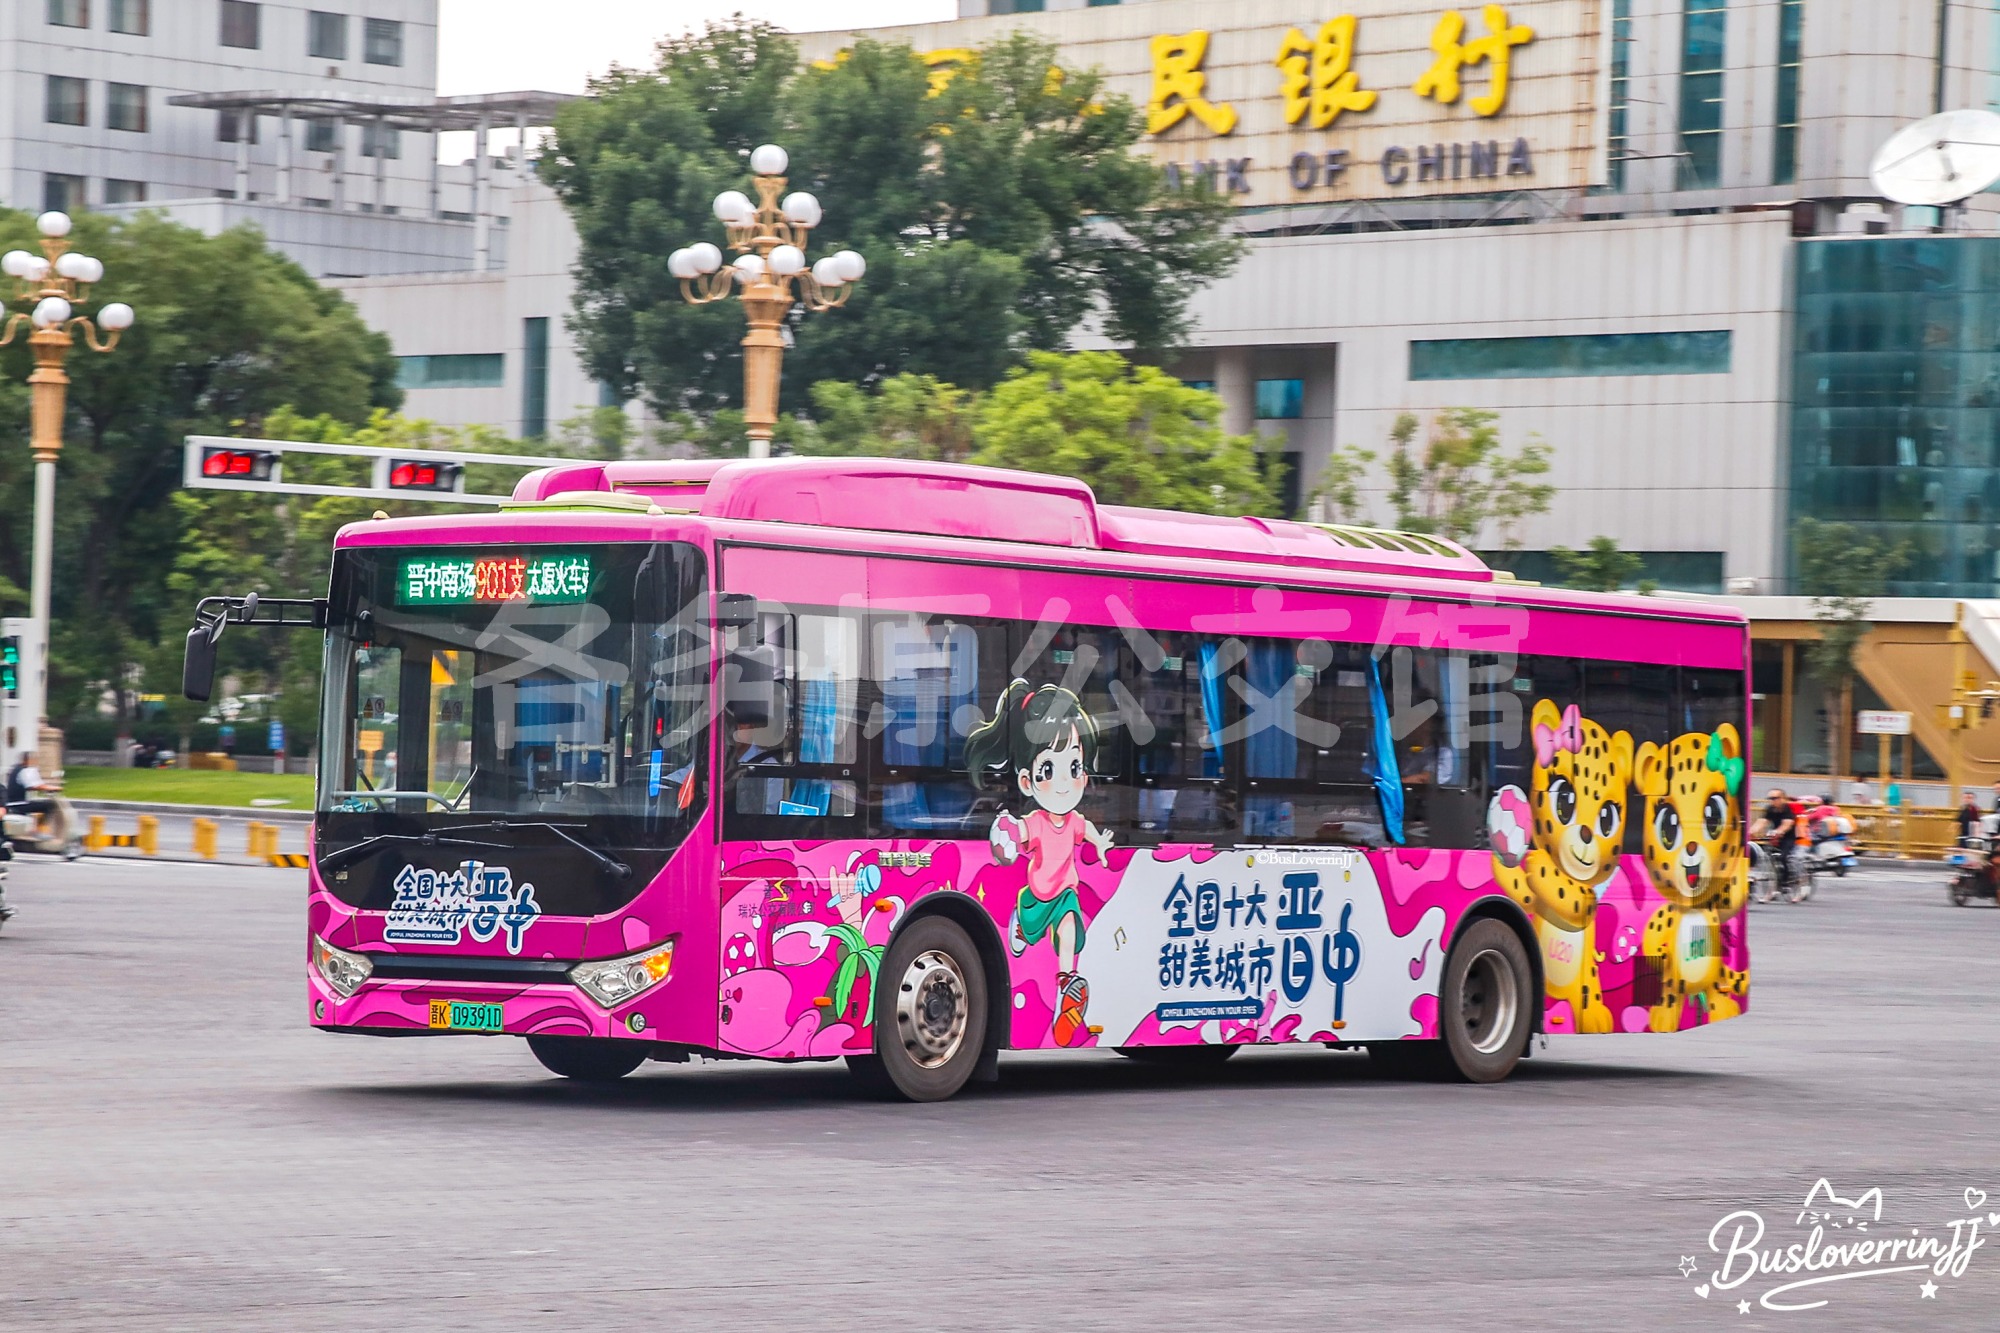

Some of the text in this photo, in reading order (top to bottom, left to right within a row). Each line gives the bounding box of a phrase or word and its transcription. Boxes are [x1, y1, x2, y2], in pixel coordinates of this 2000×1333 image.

[1163, 136, 1534, 193] ANK OF CHINA
[407, 562, 477, 599] 晋中南场
[397, 869, 464, 900] 全国十大
[1163, 873, 1268, 938] 全国十大
[1158, 937, 1276, 997] 甜美城市
